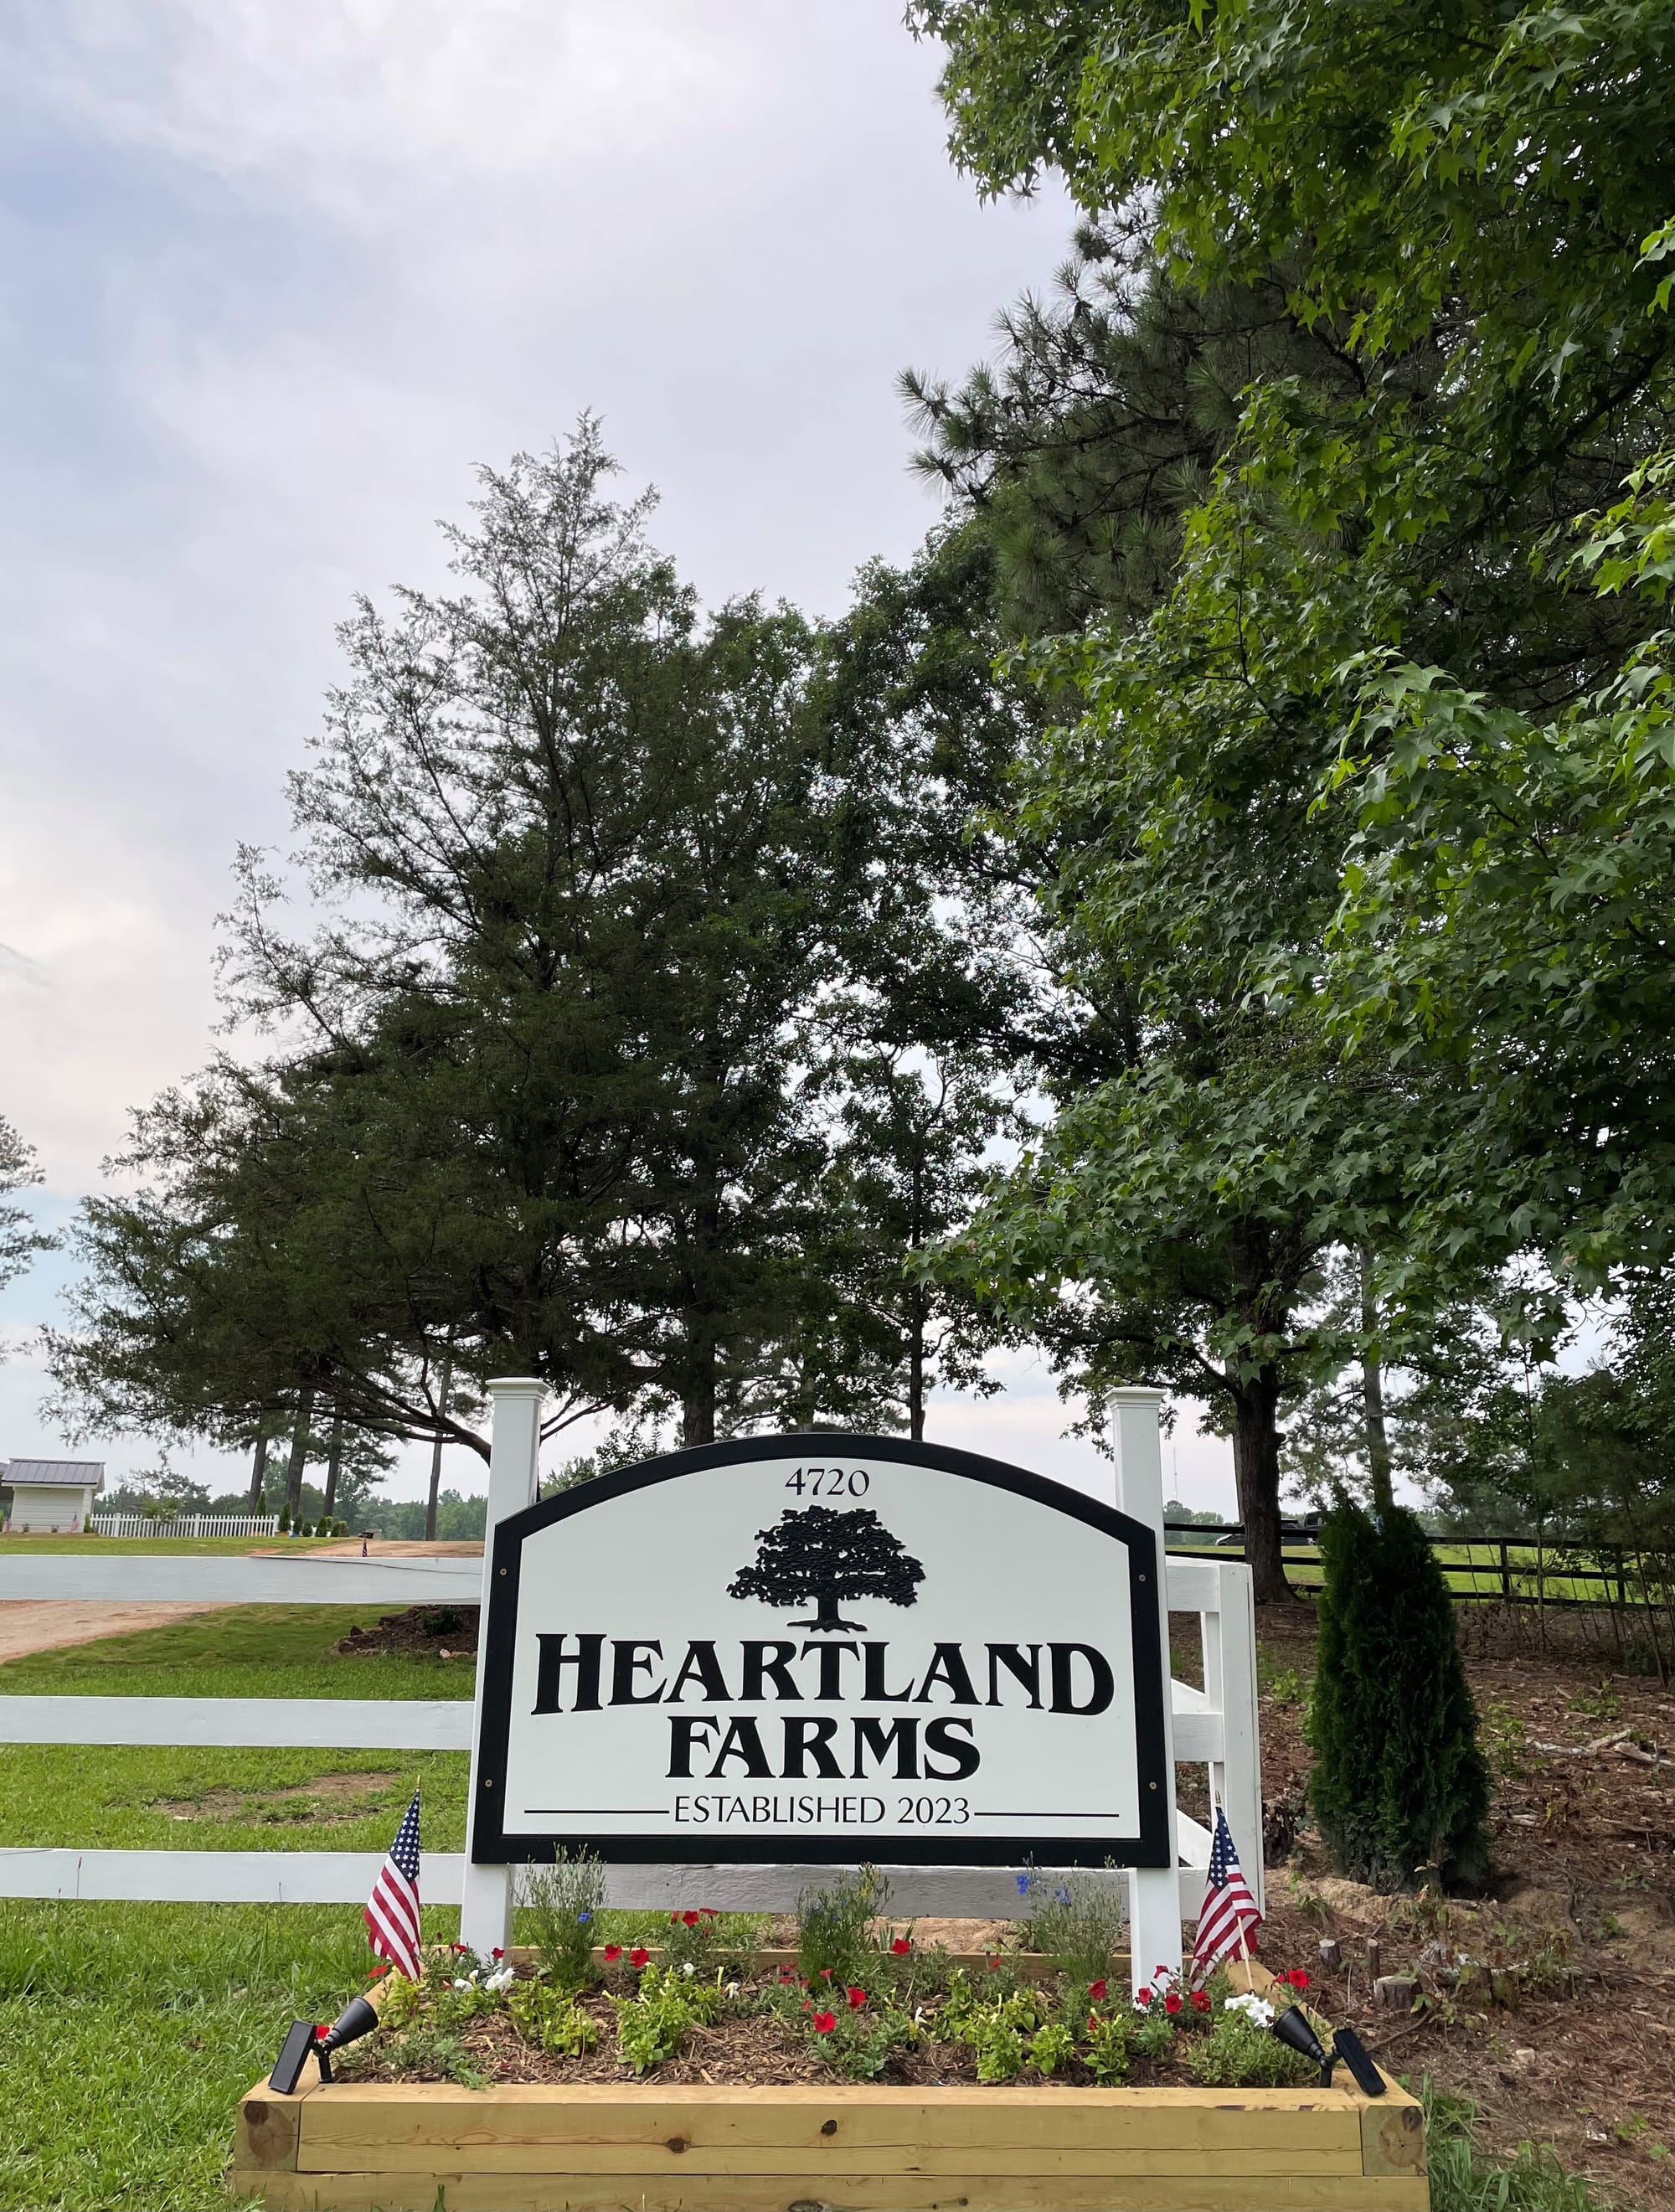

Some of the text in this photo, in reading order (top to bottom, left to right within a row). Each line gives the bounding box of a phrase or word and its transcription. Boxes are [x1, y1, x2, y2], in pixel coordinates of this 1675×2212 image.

[784, 1466, 871, 1498] 4720
[529, 1632, 1116, 1717] HEARTLAND
[664, 1714, 982, 1781] FARMS
[674, 1795, 971, 1825] ESTABLISHED 2023
